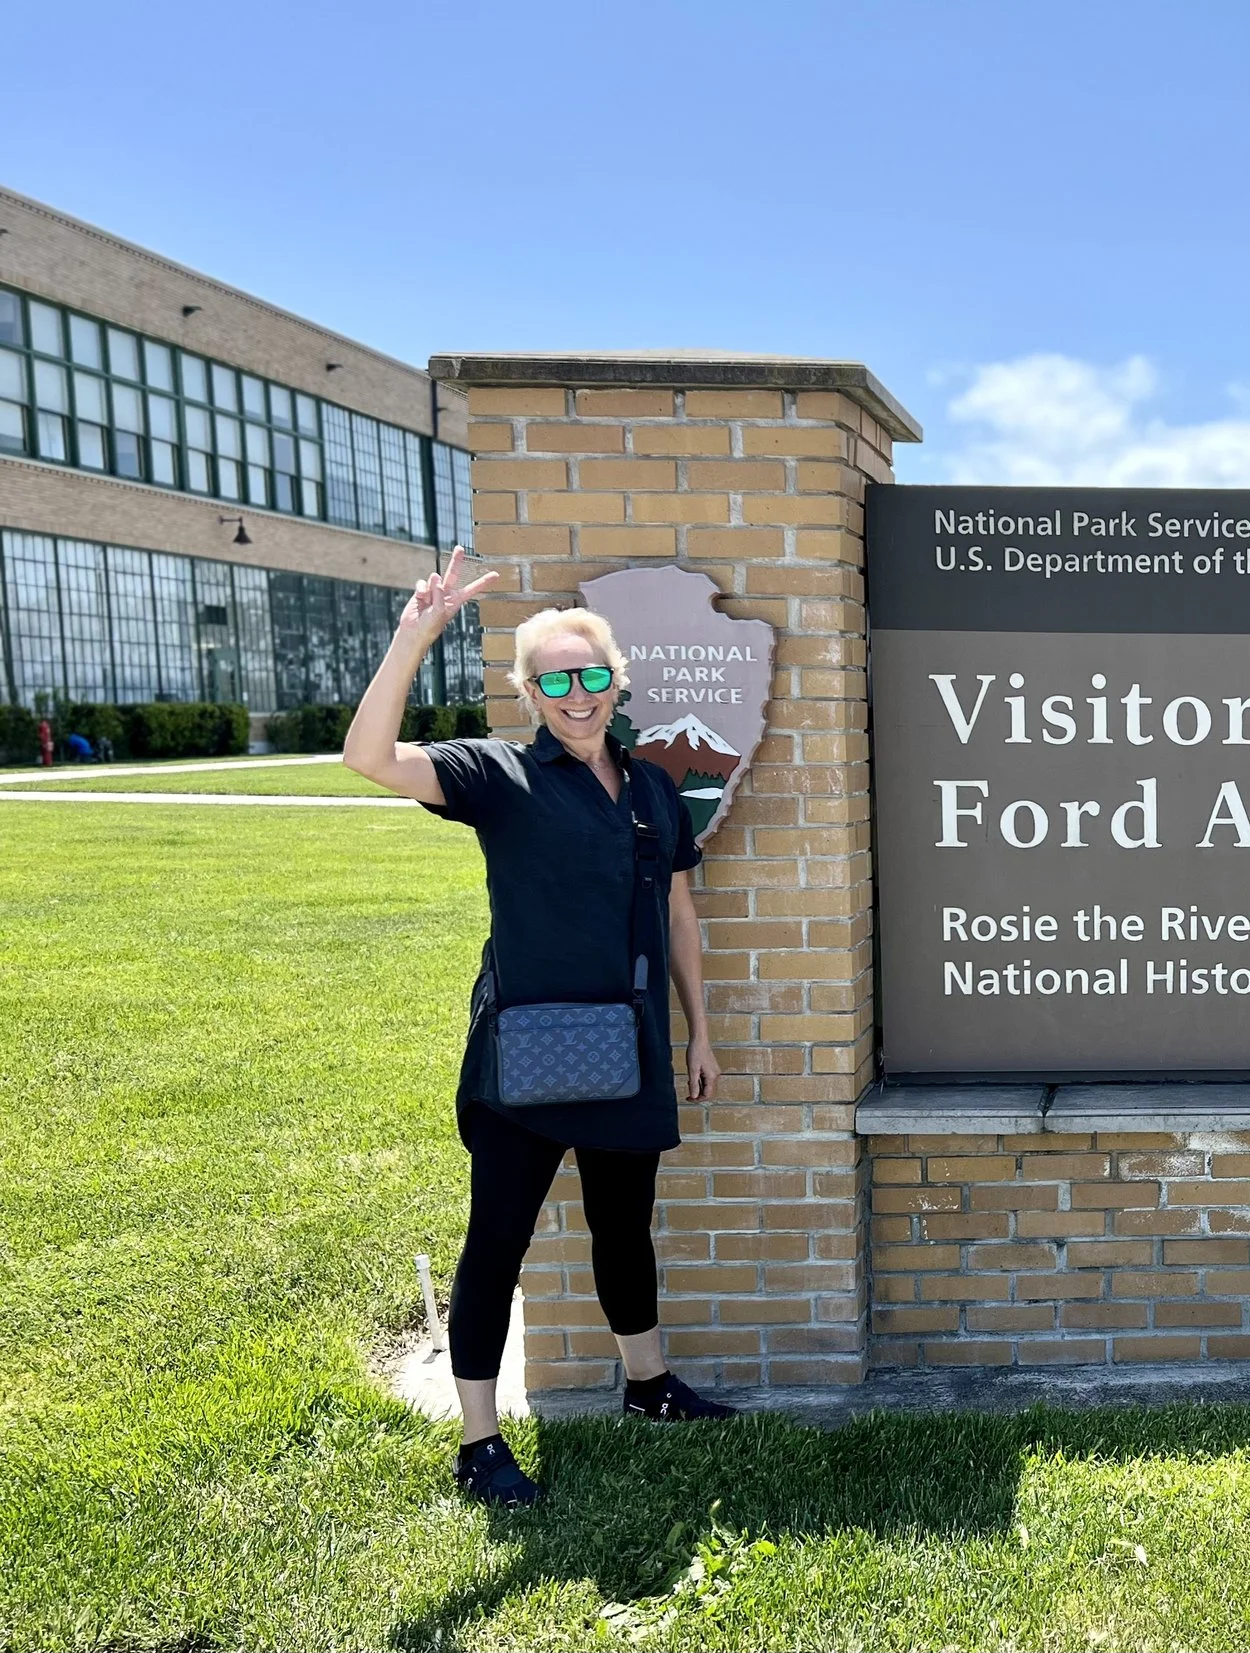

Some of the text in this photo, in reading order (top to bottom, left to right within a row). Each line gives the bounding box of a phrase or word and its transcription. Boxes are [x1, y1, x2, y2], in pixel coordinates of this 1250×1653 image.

[935, 509, 1061, 536] National
[1073, 510, 1137, 537] Park
[935, 545, 993, 572] U.S.
[1004, 547, 1184, 579] Department
[1193, 547, 1225, 574] of
[630, 645, 758, 662] NATIONAL
[662, 666, 727, 683] PARK
[647, 687, 743, 704] SERVICE
[932, 777, 1163, 849] Ford
[942, 905, 1059, 942] Rosie
[1072, 904, 1145, 942] the
[943, 958, 1128, 996] National
